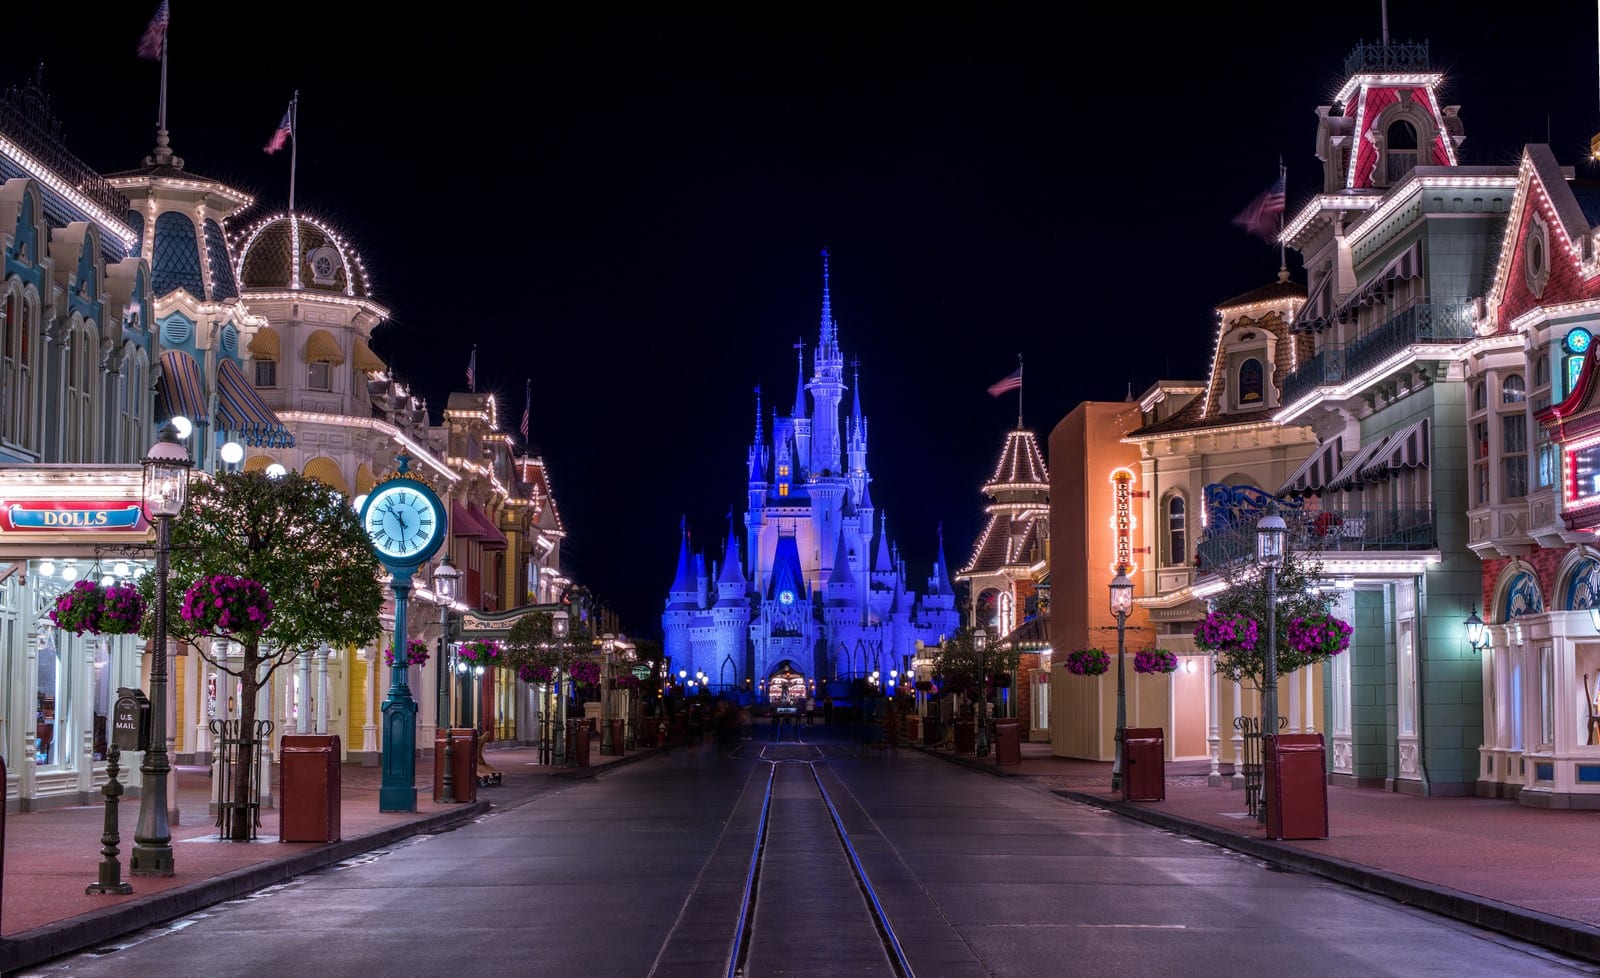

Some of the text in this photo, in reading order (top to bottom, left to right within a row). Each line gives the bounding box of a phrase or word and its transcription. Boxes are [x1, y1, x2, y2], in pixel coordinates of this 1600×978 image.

[43, 511, 108, 525] DOLLS
[1118, 483, 1128, 563] CRYSTAL ARTS
